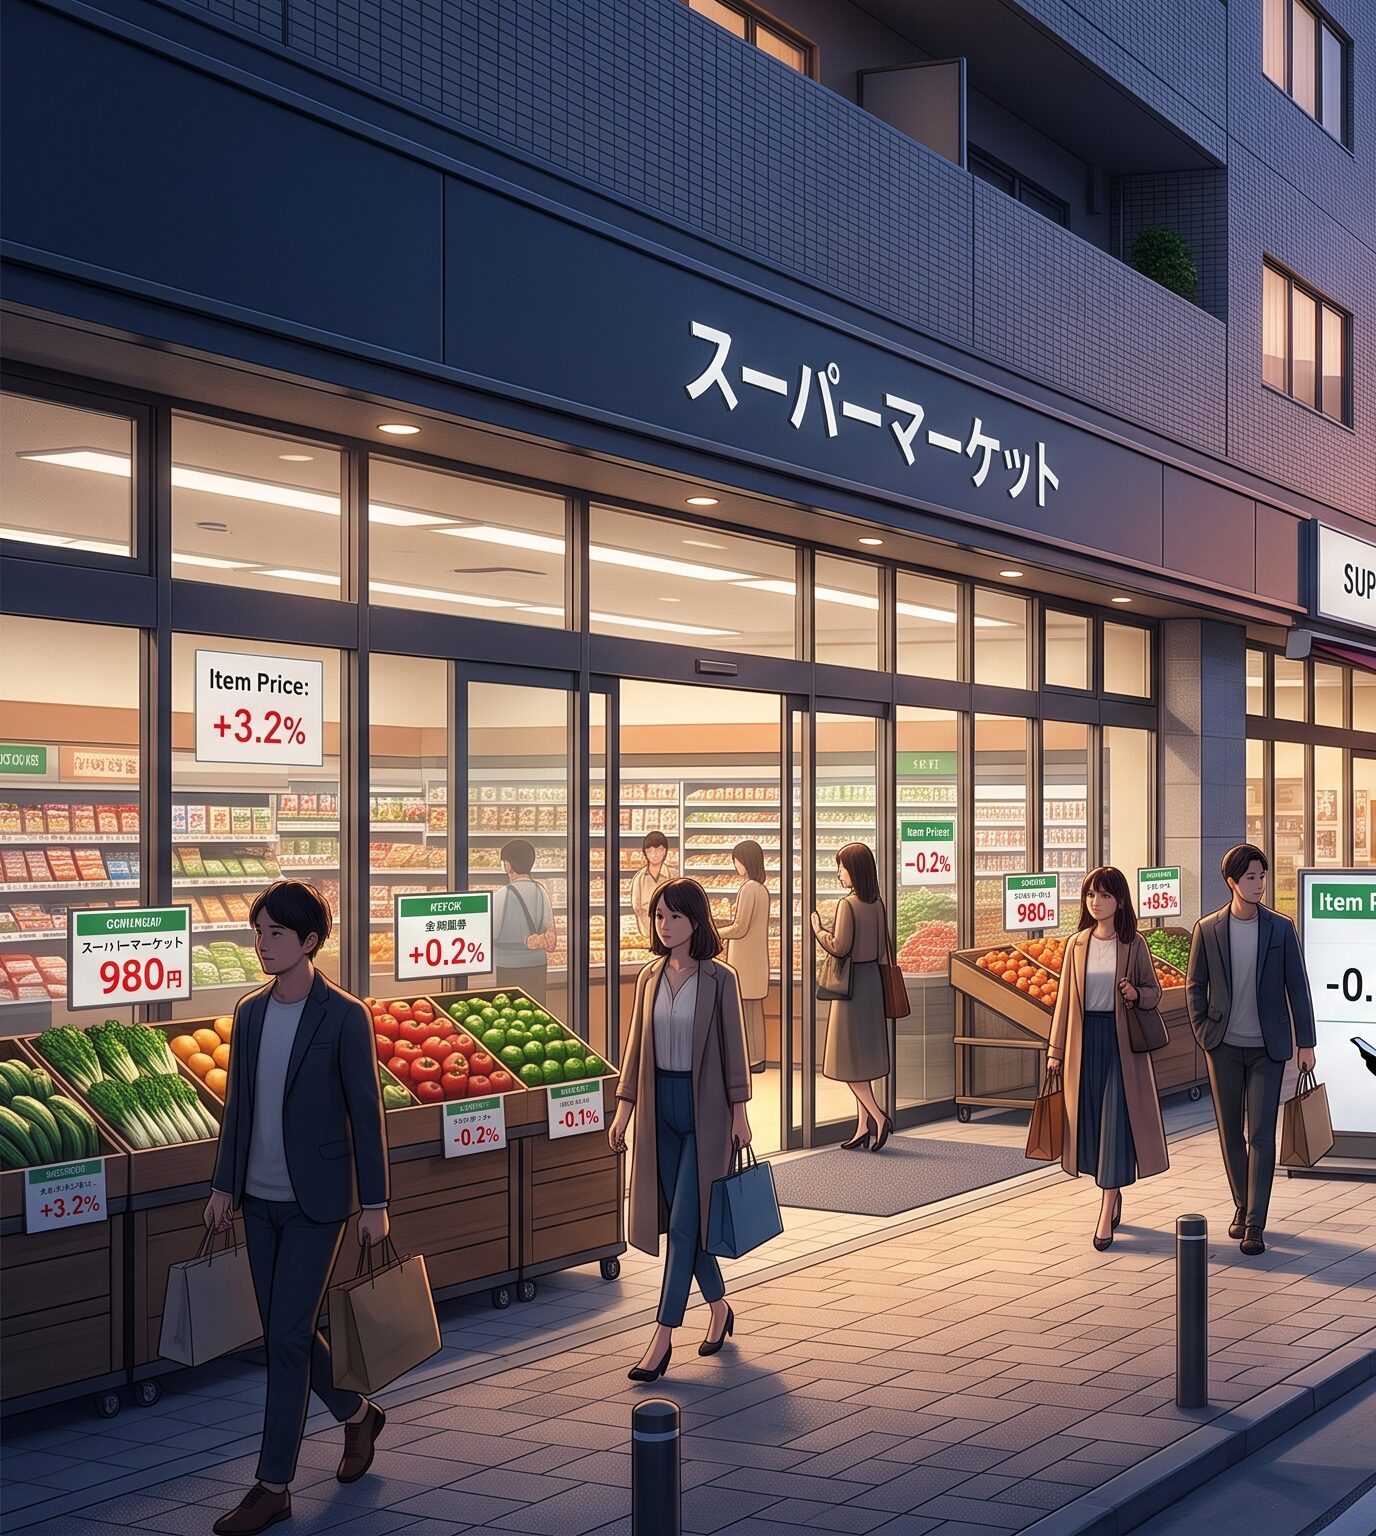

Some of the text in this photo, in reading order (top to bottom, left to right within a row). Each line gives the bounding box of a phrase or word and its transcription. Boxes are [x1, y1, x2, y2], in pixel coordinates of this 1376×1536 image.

[685, 320, 1060, 507] スーパーマーケット
[210, 668, 309, 696] Item Price:
[213, 708, 306, 745] +3.2%
[905, 851, 951, 873] -0.2%
[1320, 892, 1363, 912] Item
[409, 937, 485, 967] +0.2%
[99, 956, 182, 994] 980円
[558, 1108, 600, 1128] -0.1%
[453, 1125, 500, 1146] -0.2%
[40, 1194, 100, 1218] +3.2%
